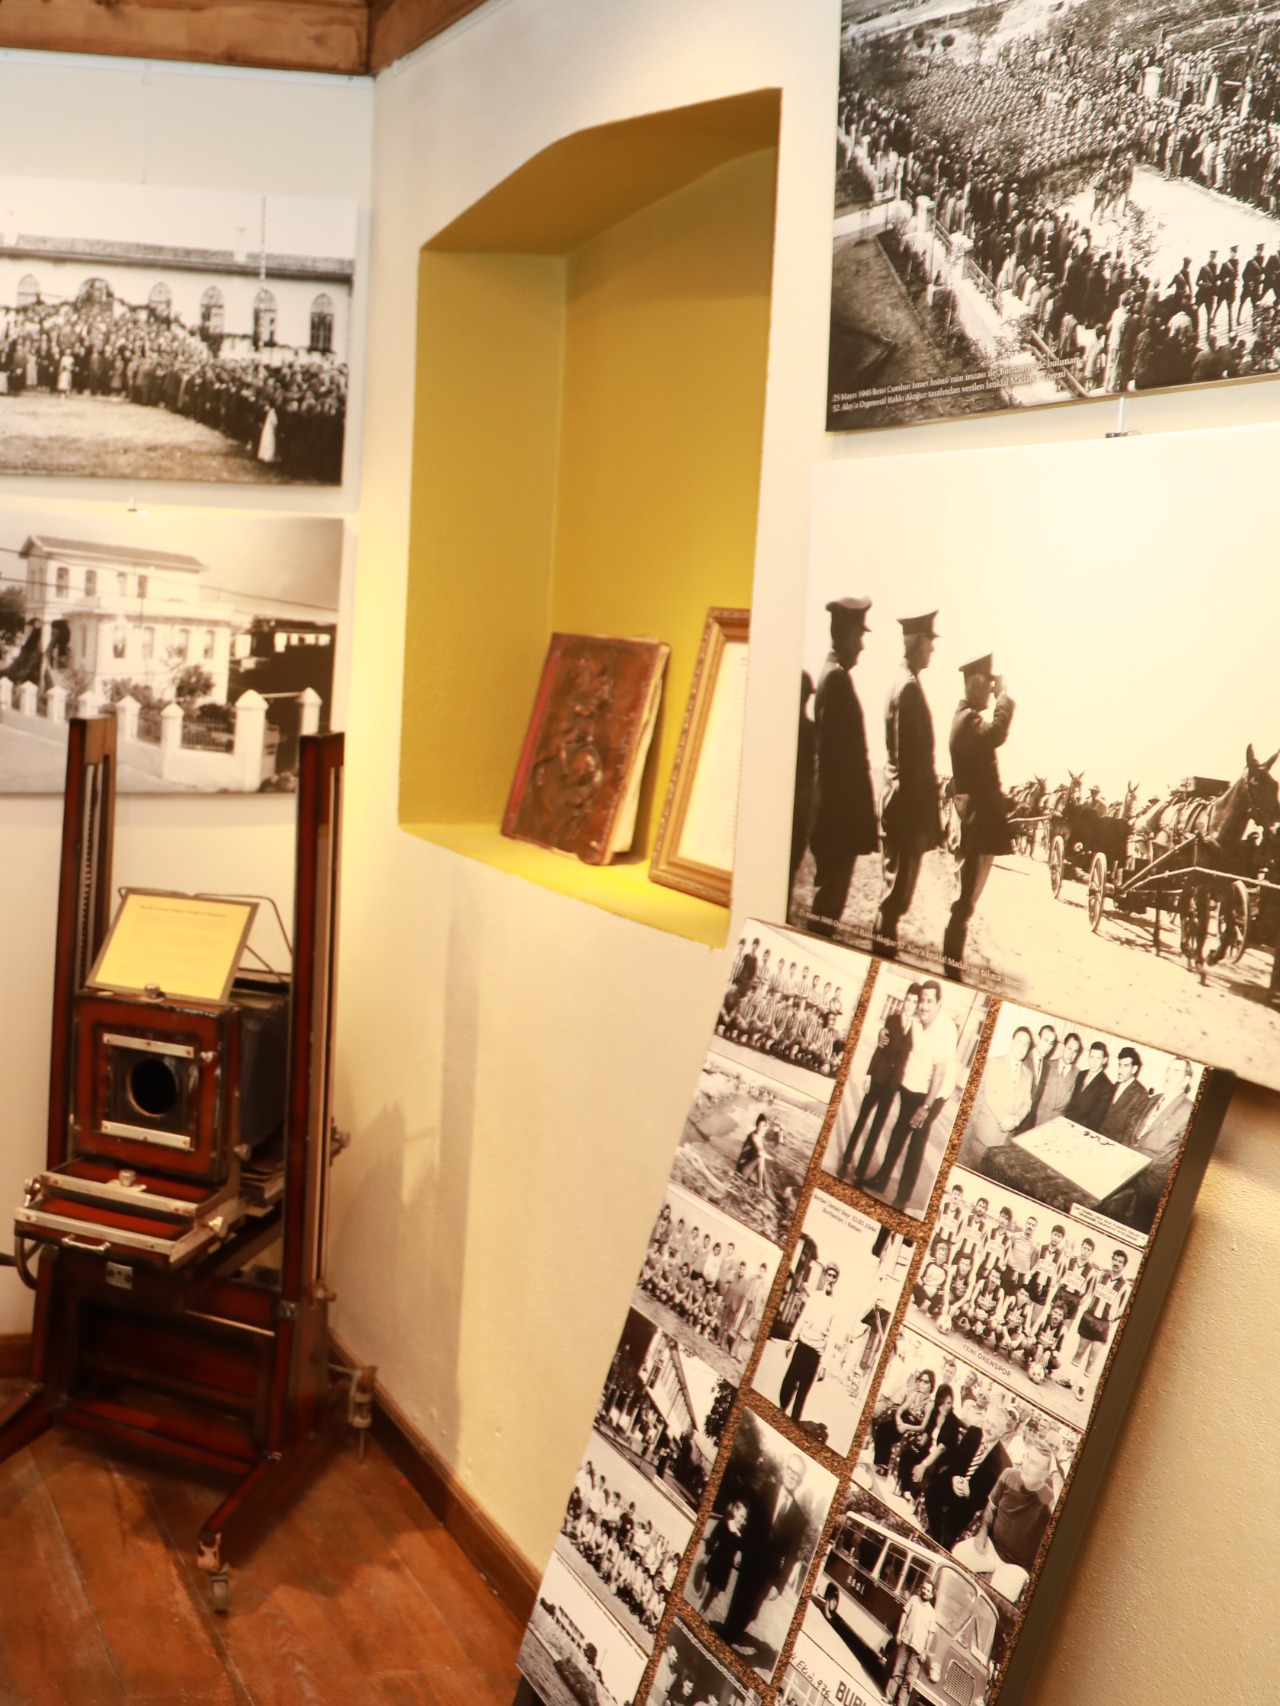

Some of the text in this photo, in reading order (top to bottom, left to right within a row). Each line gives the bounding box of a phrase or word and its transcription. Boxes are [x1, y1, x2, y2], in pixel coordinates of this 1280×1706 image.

[1048, 355, 1080, 367] bulunan
[929, 385, 960, 397] tarafından
[962, 382, 984, 392] verilen
